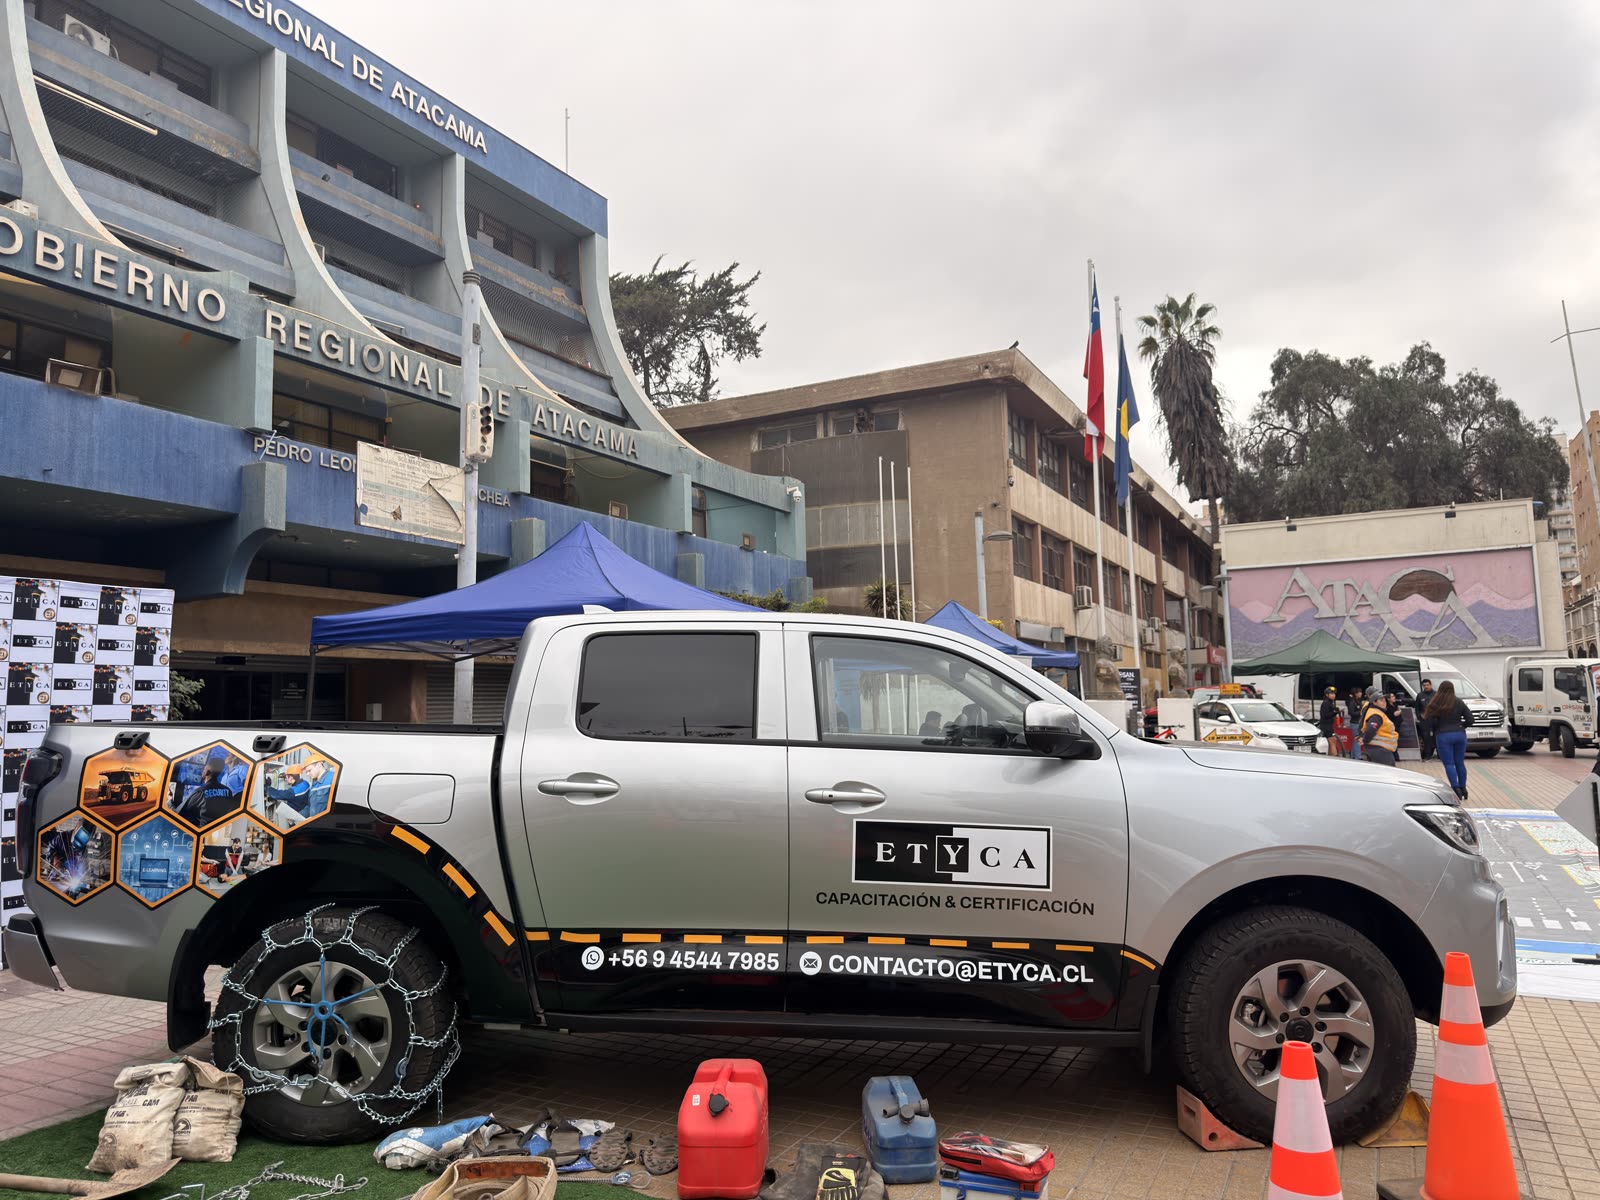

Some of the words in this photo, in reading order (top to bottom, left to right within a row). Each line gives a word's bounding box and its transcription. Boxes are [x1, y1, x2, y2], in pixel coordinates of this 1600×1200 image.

[352, 54, 383, 91] DE
[391, 80, 488, 153] ATACAMA
[265, 309, 452, 398] REGIONAL
[479, 383, 511, 417] DE
[533, 403, 639, 459] ATACAMA
[253, 436, 312, 463] PEDRO
[16, 596, 56, 606] ETYCA
[101, 603, 137, 611] ETYCA
[56, 641, 94, 649] ETYCA
[204, 788, 230, 798] SECURITY
[875, 842, 1036, 869] ETYCA
[816, 891, 941, 908] CAPACITACIÓN
[944, 895, 957, 908] &
[960, 896, 1095, 916] CERTIFICACIÓN
[608, 949, 648, 967] +56
[652, 950, 665, 968] 9
[669, 950, 722, 969] 4544
[728, 951, 780, 971] 7985
[828, 953, 1094, 983] CONTACTO@ETYCA.CL
